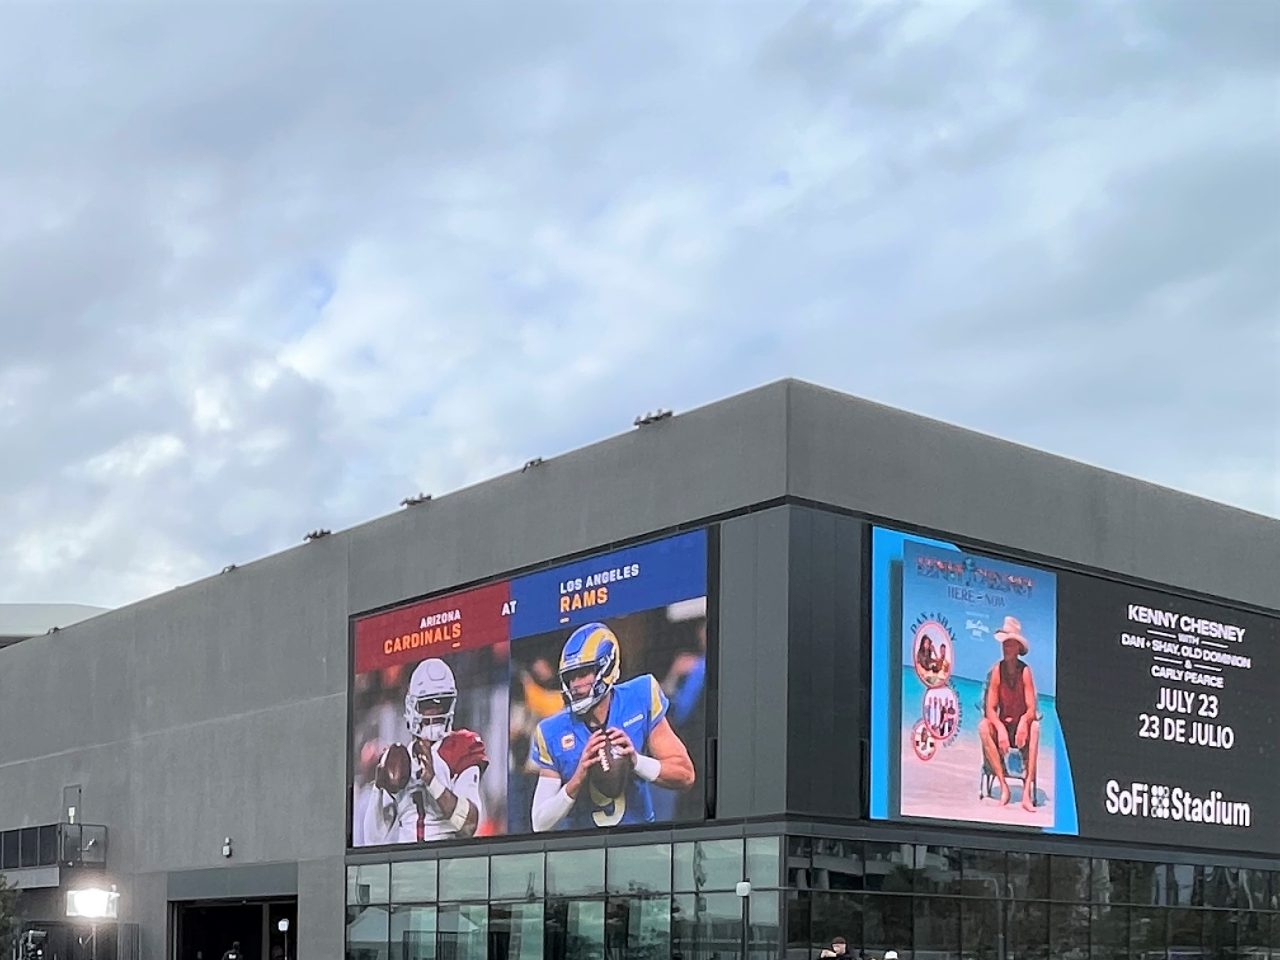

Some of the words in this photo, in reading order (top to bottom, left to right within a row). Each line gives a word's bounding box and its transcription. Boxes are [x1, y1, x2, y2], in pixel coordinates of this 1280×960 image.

[560, 579, 582, 594] LOS
[585, 564, 639, 587] ANGELES
[501, 601, 517, 616] AT
[560, 587, 608, 613] RAMS
[420, 609, 461, 629] ARIZONA
[1128, 604, 1179, 629] KENNY
[1180, 616, 1245, 642] CHESNEY
[383, 623, 461, 654] CARDINALS
[1121, 633, 1145, 648] DAN
[1152, 640, 1180, 656] SHAY,
[1181, 646, 1202, 659] OLD
[1203, 650, 1251, 668] DOMINION
[1178, 633, 1200, 645] WITH
[1151, 665, 1183, 681] CARLY
[1185, 671, 1224, 688] PEARCE
[1156, 687, 1195, 713] JULY
[1198, 694, 1218, 718] 23
[1138, 713, 1160, 738] 23
[1164, 718, 1185, 742] DE
[1189, 722, 1234, 749] JULIO
[1106, 780, 1148, 817] SoFi
[1171, 787, 1251, 826] Stadium
